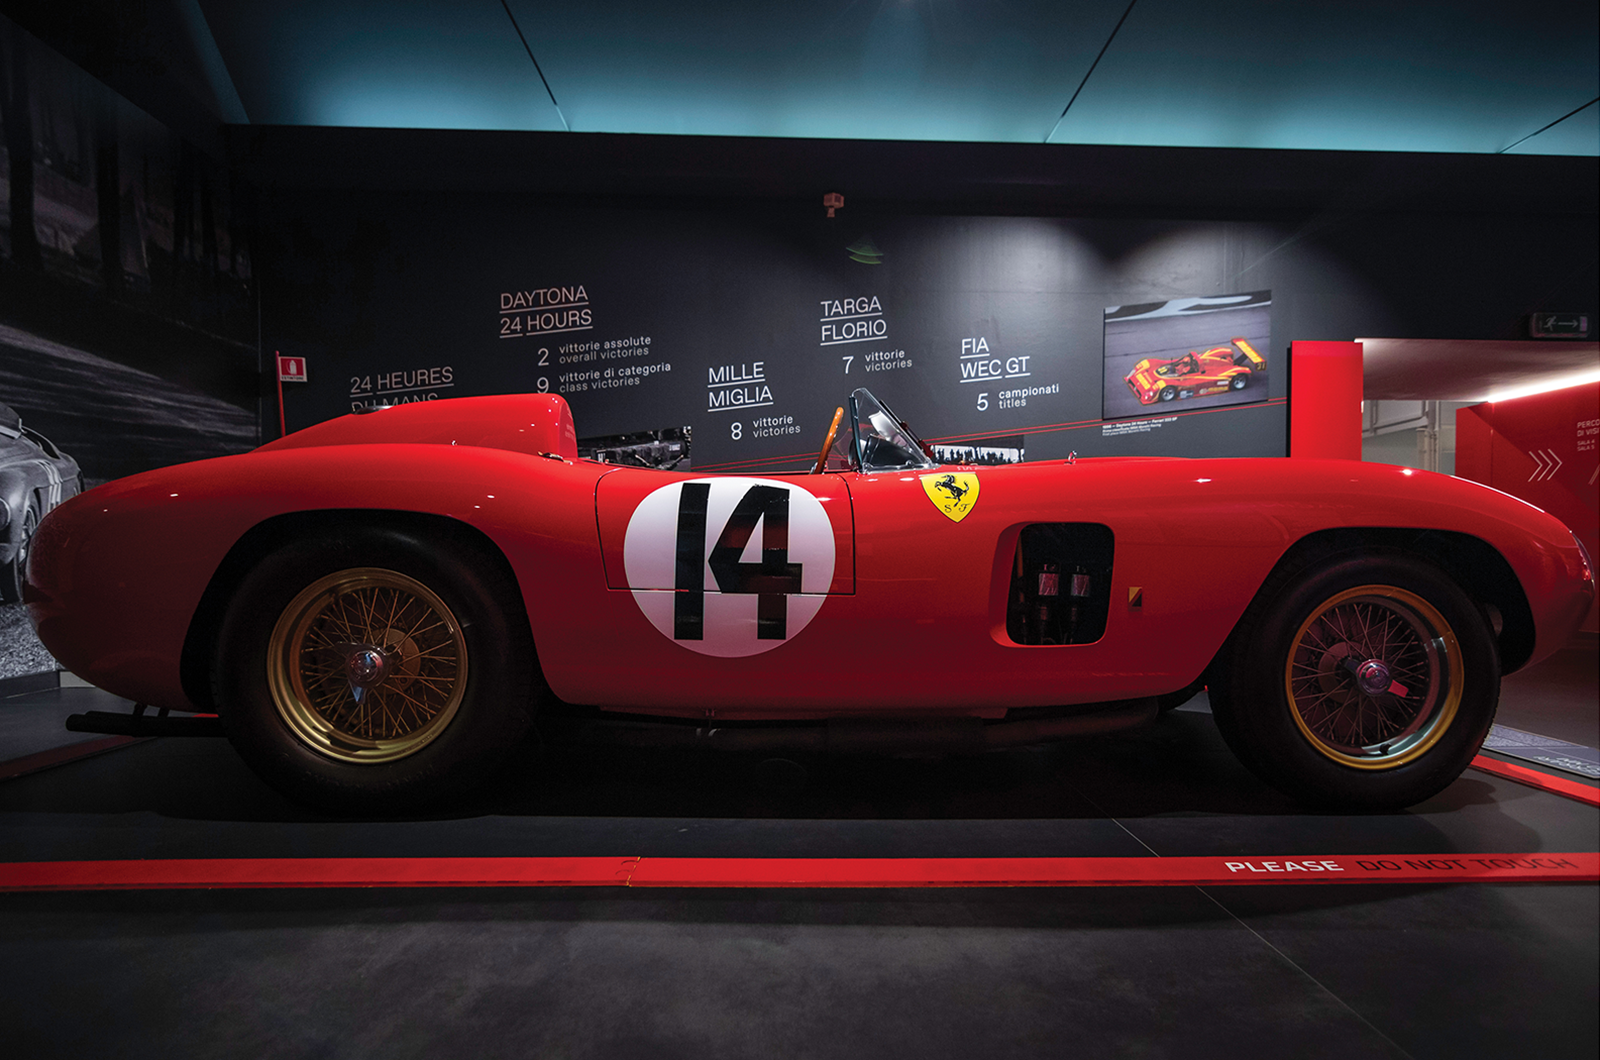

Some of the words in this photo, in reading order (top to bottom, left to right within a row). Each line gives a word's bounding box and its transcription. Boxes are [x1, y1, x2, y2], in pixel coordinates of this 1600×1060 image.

[500, 285, 588, 310] DAYTONA
[820, 295, 882, 317] TARGA
[500, 316, 520, 334] 24
[527, 308, 592, 331] HOURS
[821, 319, 887, 341] FLORIO
[559, 341, 600, 354] vittorie
[603, 336, 651, 350] assolute
[559, 351, 597, 364] overall
[600, 346, 649, 360] victories
[961, 336, 990, 355] FIA
[537, 347, 550, 367] 2
[842, 355, 854, 375] 7
[865, 349, 905, 362] vittorie
[865, 359, 912, 372] victories
[559, 370, 600, 383] vittorie
[603, 367, 615, 378] di
[618, 362, 671, 376] categoria
[708, 361, 765, 384] MILLE
[960, 359, 1002, 379] WEC
[1005, 355, 1030, 374] GT
[350, 375, 372, 393] 24
[377, 366, 453, 390] HEURES
[536, 376, 550, 394] 9
[559, 382, 588, 393] class
[591, 376, 640, 389] victories
[708, 385, 773, 408] MIGLIA
[998, 383, 1059, 399] campionati
[976, 392, 989, 412] 5
[998, 398, 1027, 409] titles
[730, 421, 742, 441] 8
[752, 414, 793, 428] vittorie
[752, 425, 801, 438] victories
[674, 483, 802, 640] 14
[1225, 861, 1344, 873] PLEASE
[1355, 860, 1402, 871] DO
[1404, 860, 1467, 871] NOT
[1468, 859, 1579, 870] TOUCH
